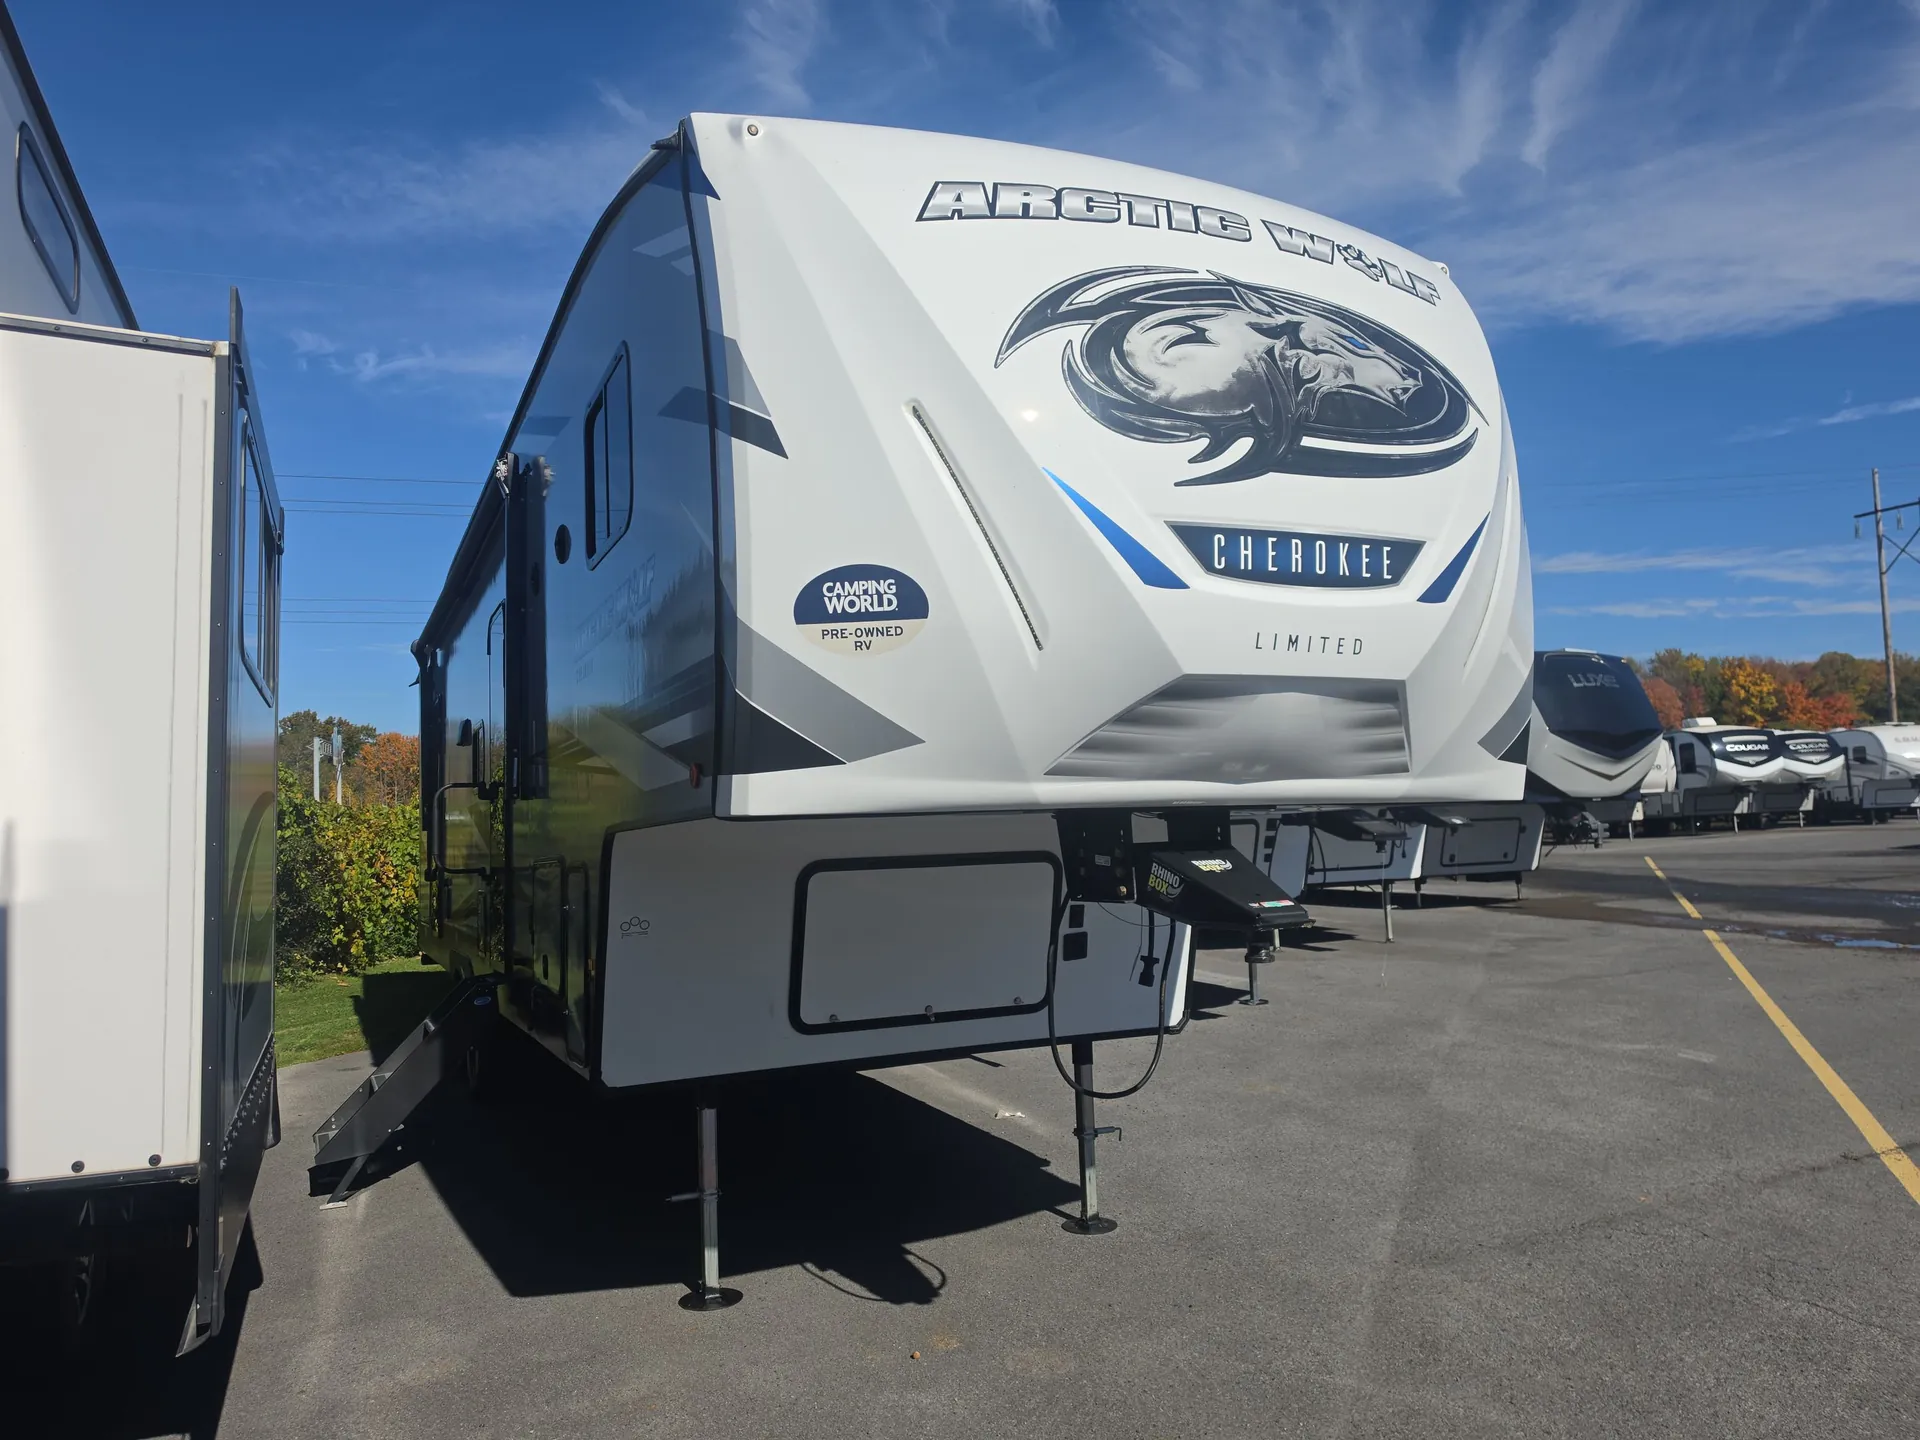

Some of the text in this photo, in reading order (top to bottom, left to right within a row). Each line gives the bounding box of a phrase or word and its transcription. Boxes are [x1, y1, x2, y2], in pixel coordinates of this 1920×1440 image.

[915, 180, 1252, 242] ARCTIC
[1213, 533, 1392, 579] CHEROKEE
[822, 579, 897, 597] CAMPING
[821, 625, 904, 639] PRE-OWNED
[854, 640, 872, 651] RV
[1255, 632, 1363, 655] LIMITED
[1567, 673, 1620, 688] LUXE
[1725, 743, 1770, 752] COUGAR
[1148, 873, 1169, 896] BOX
[1151, 862, 1180, 888] RHINO
